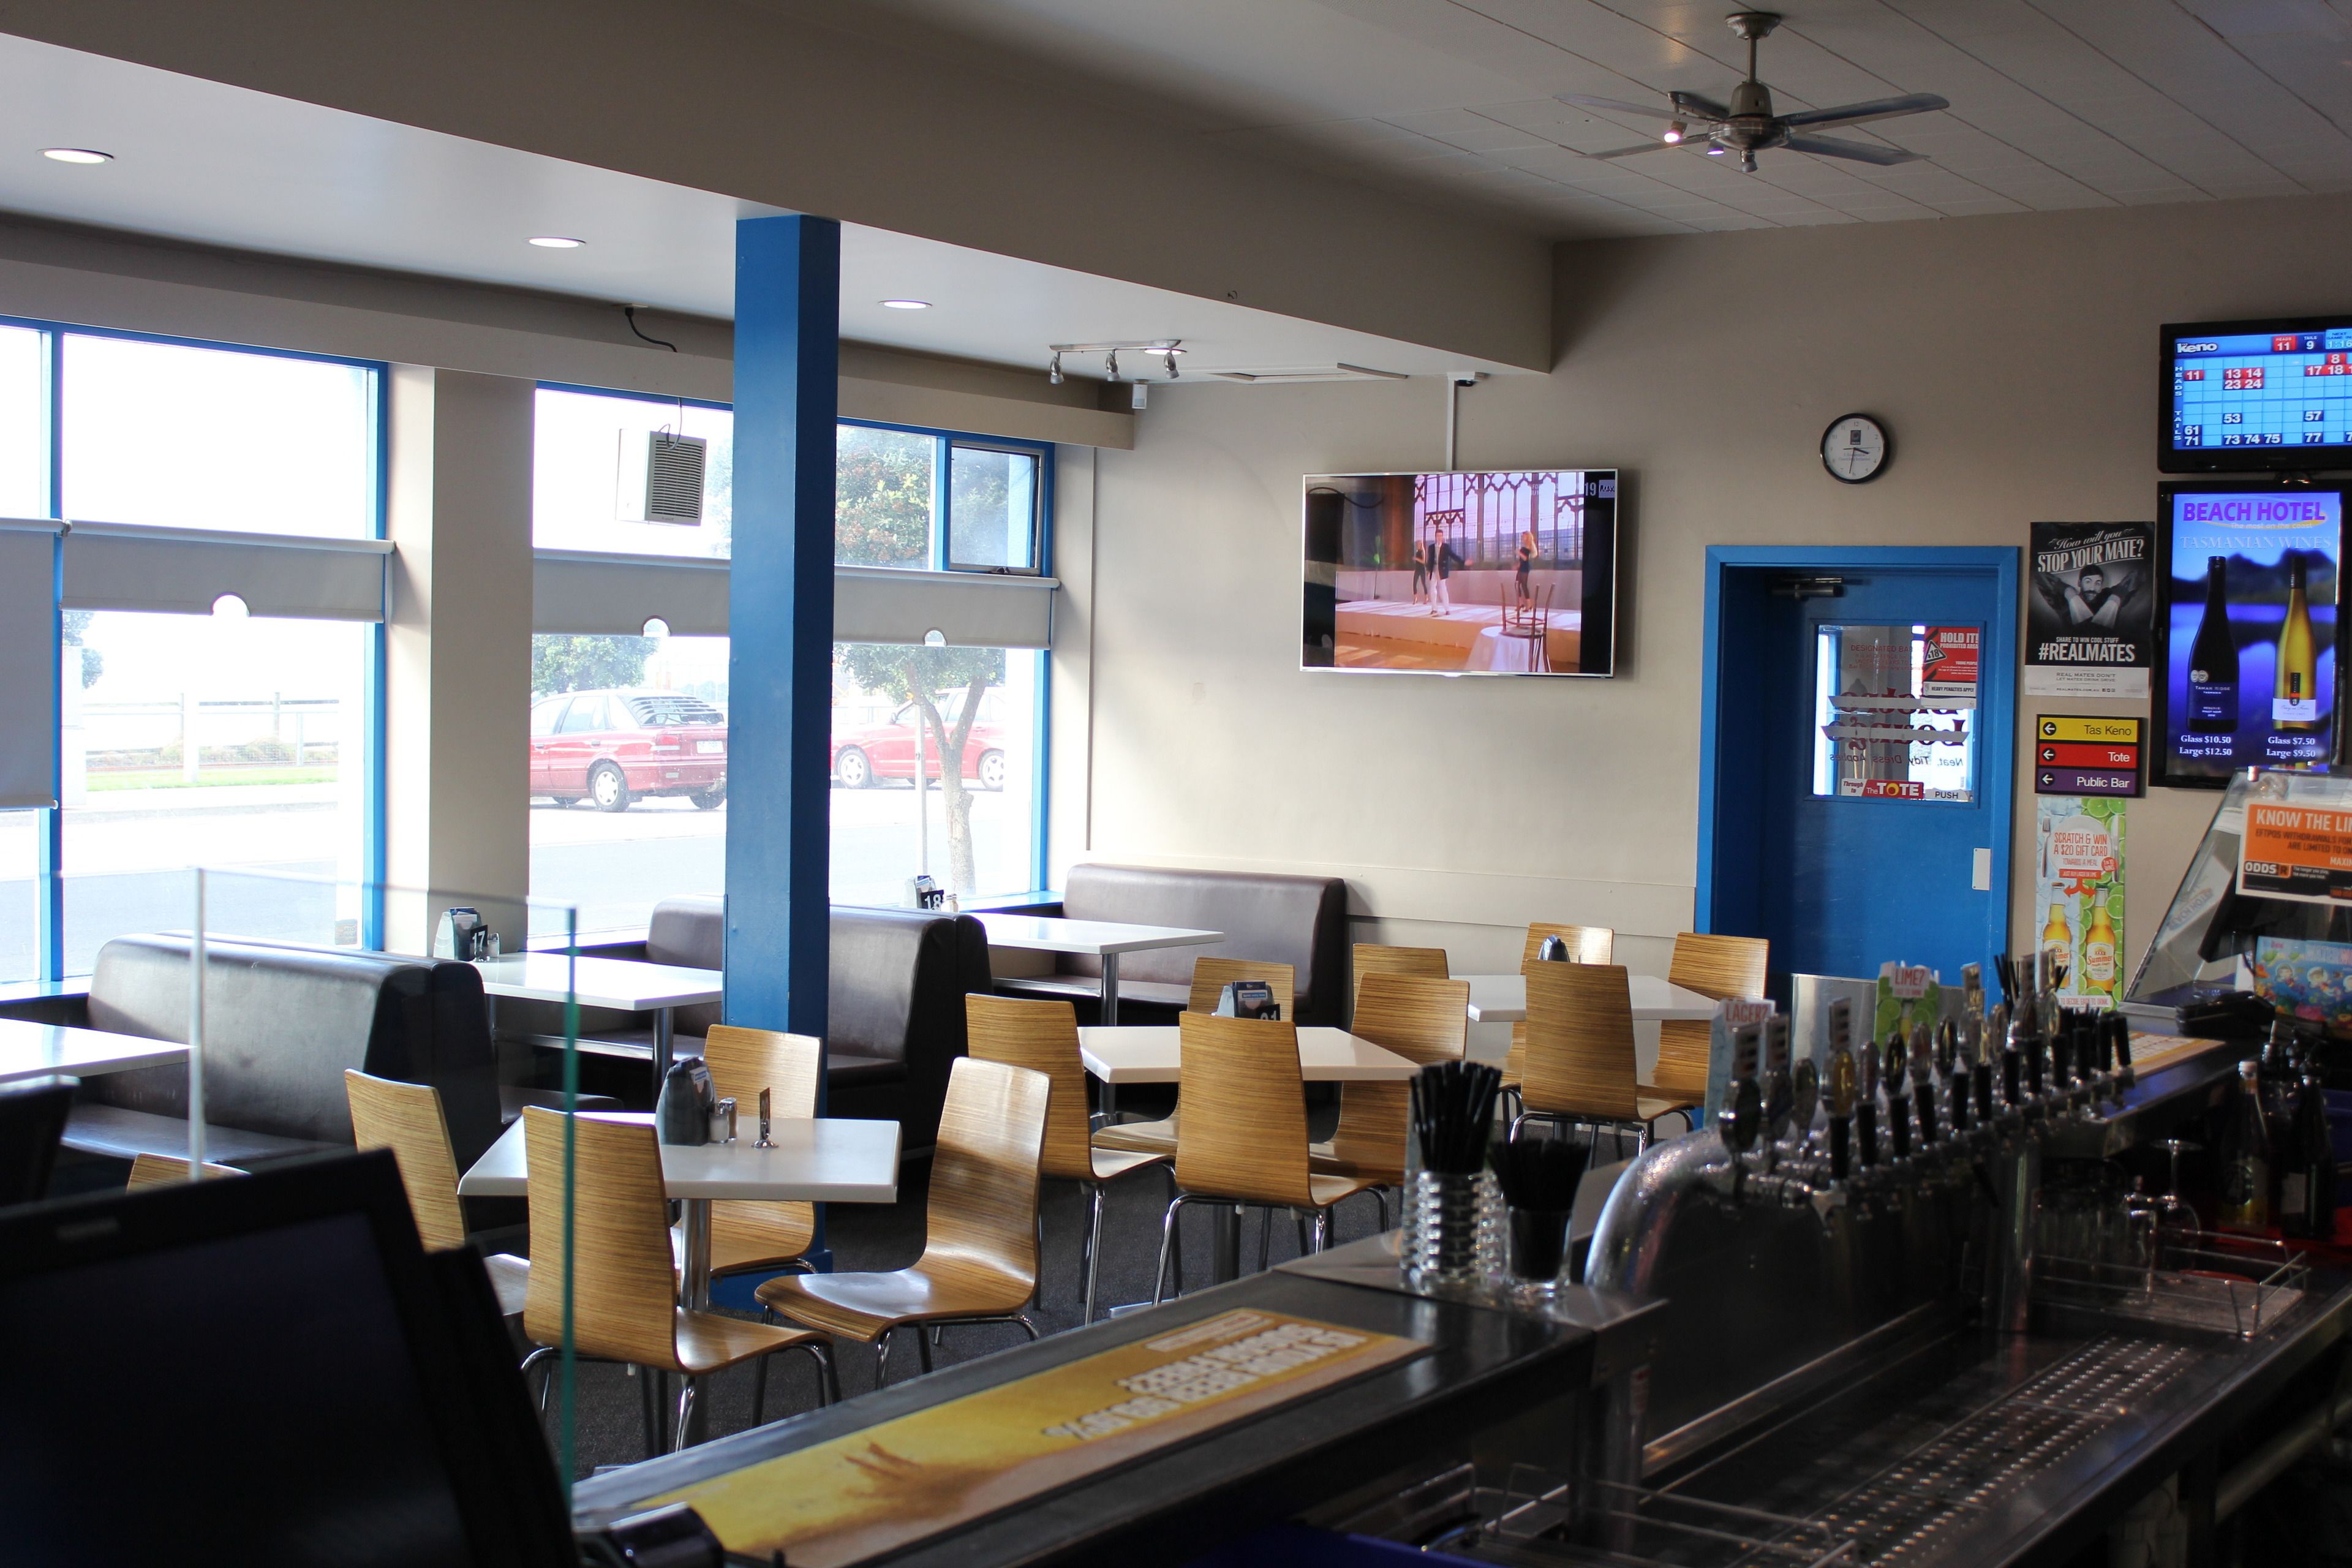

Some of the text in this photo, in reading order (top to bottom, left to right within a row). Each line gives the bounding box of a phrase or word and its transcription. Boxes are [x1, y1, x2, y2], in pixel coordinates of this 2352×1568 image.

[2277, 342, 2290, 350] 11
[2306, 341, 2314, 350] 9
[2331, 354, 2340, 364] 8
[2187, 364, 2343, 380] 11 13 14 17 18
[2224, 379, 2261, 390] 23 24
[2223, 411, 2321, 423] 53 57
[2184, 426, 2199, 435] 61
[2184, 436, 2199, 446] 71
[2224, 435, 2240, 445] 73
[2244, 435, 2260, 444] 74
[2264, 434, 2280, 443] 75
[2305, 433, 2321, 442] 77
[1585, 482, 1596, 496] 19
[2184, 502, 2325, 521] BEACH HOTEL
[2054, 530, 2122, 549] How will you
[2180, 537, 2332, 549] TASMANIAN WINES
[2038, 539, 2144, 572] STOP YOUR MATE?
[1940, 632, 1978, 643] HOLD IT!
[2038, 643, 2135, 662] #REALMATES
[2084, 725, 2132, 736] Tas Keno
[2108, 752, 2130, 762] Tote
[2179, 747, 2203, 757] Large
[2266, 748, 2291, 759] Large
[2077, 777, 2130, 788] Public Bar
[1877, 783, 1920, 796] TOTE
[2256, 809, 2301, 827] KNOW
[2305, 813, 2331, 831] THE
[2054, 832, 2107, 845] SCRATCH & WIN
[2256, 829, 2281, 838] EFTPOS
[2283, 832, 2336, 843] WITHDRAWALS
[2054, 844, 2108, 856] A $20 GIFT CARD
[2304, 843, 2330, 853] LIMITED
[2245, 862, 2277, 873] ODDS
[925, 894, 941, 910] 18
[472, 930, 486, 953] 17
[2087, 956, 2113, 965] Summer
[1895, 968, 1925, 985] LIME?
